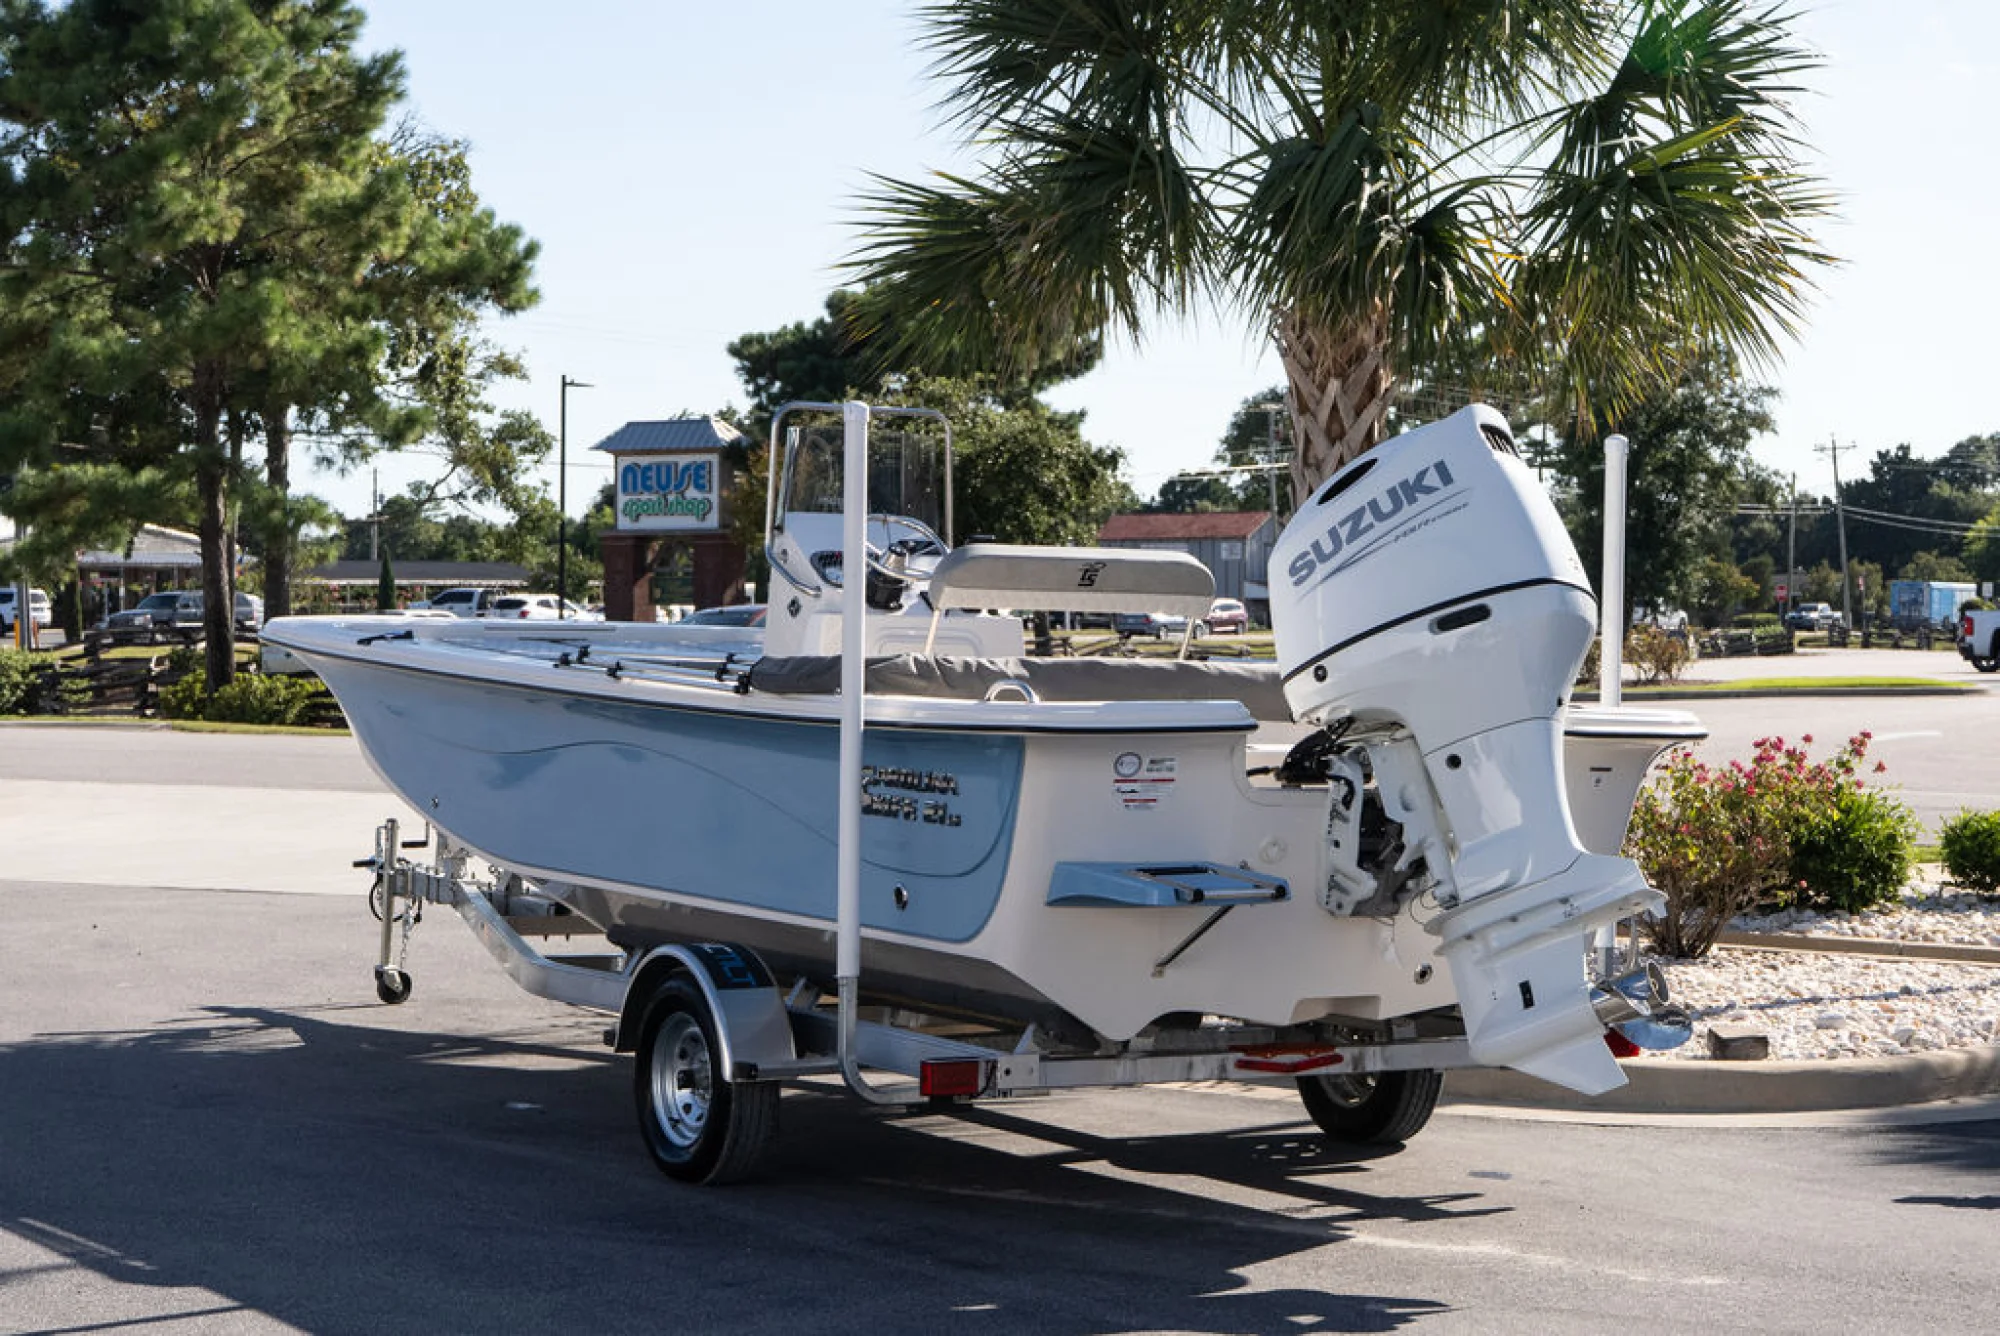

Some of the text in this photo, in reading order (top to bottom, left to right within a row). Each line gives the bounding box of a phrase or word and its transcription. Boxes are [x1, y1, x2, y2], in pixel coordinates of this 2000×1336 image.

[621, 461, 711, 495] NEUSE
[668, 494, 712, 522] shop
[1289, 459, 1454, 587] SUZUKI
